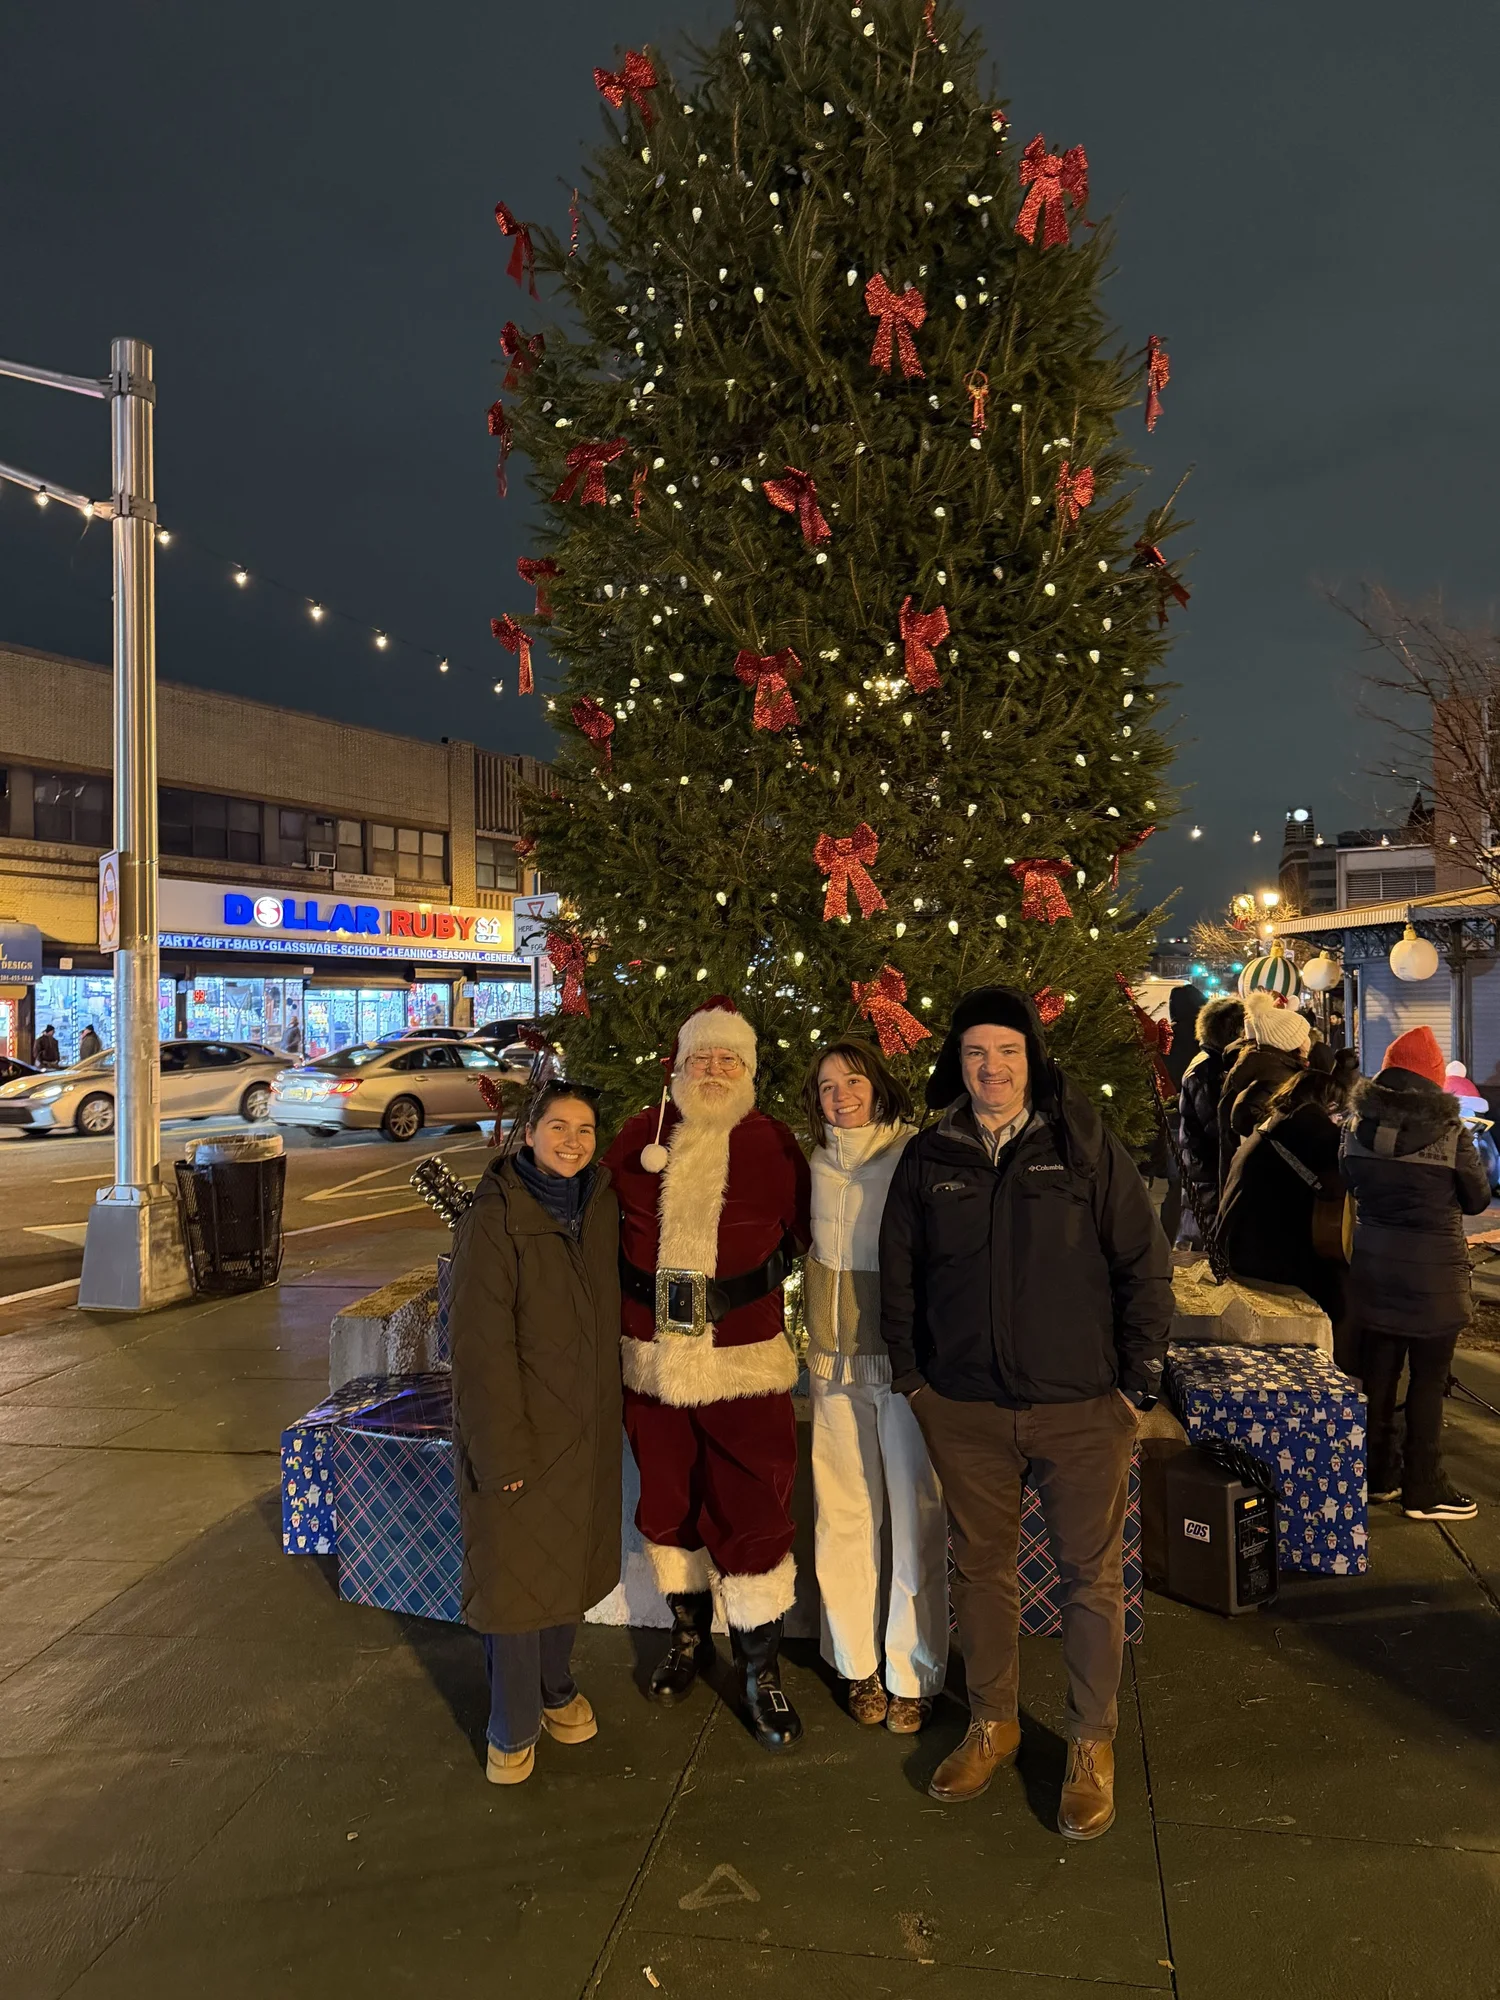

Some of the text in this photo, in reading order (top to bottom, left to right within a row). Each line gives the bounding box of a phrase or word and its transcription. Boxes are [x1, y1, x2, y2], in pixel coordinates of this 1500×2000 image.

[390, 909, 477, 940] RUBY
[518, 925, 534, 933] HERE
[158, 933, 199, 948] PARTY
[202, 937, 231, 949] GIFT
[232, 938, 266, 951] BABY
[269, 940, 338, 955] GLASSWARE
[340, 945, 383, 957] SCHOOL
[386, 948, 433, 959] CLEANING
[436, 951, 482, 961] SEASONAL
[1, 961, 33, 970] DESIGN
[1186, 1522, 1208, 1537] CDS
